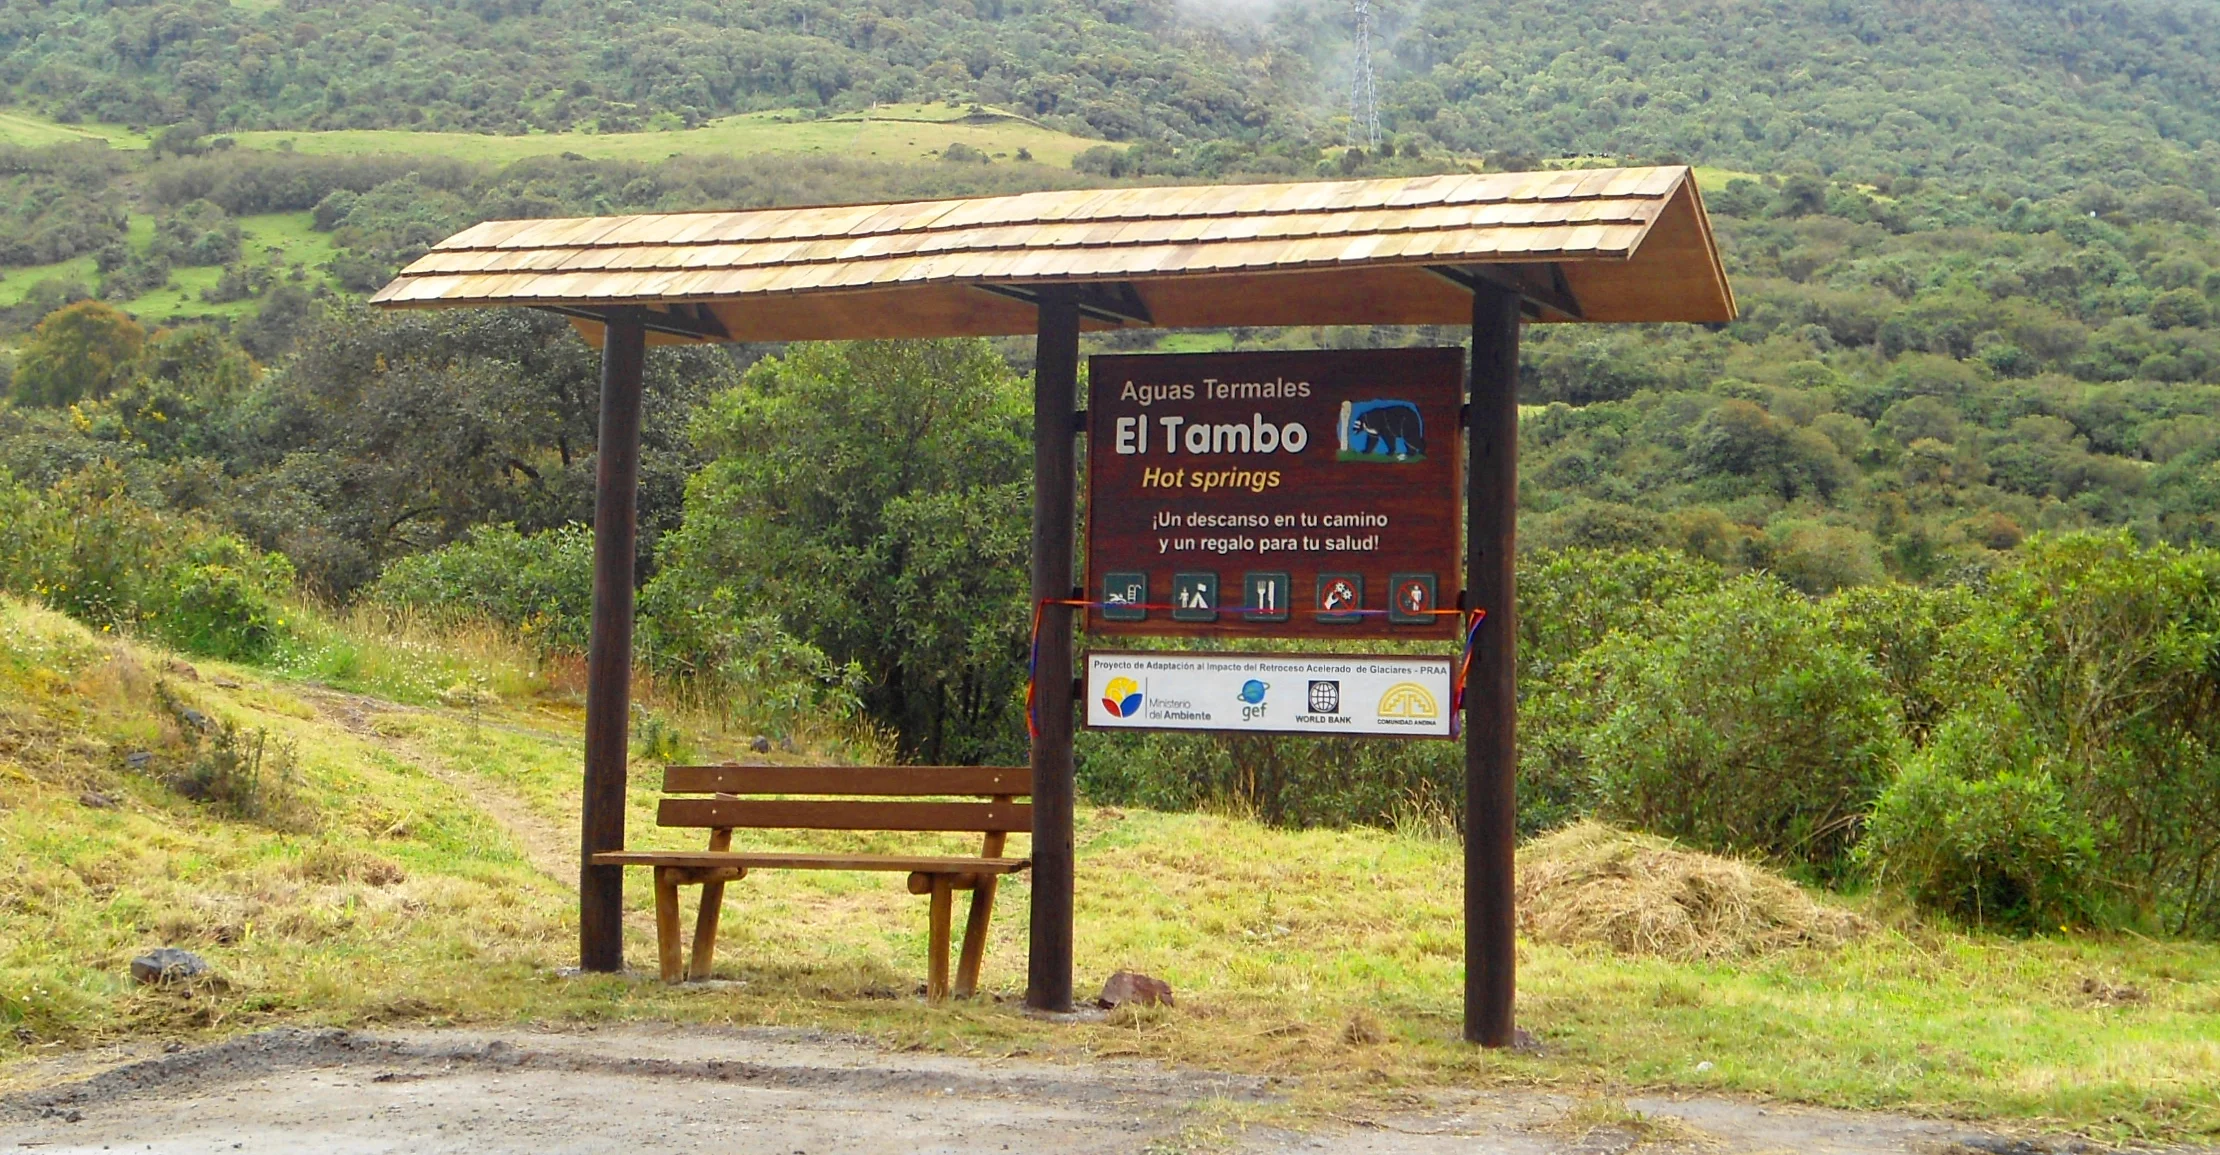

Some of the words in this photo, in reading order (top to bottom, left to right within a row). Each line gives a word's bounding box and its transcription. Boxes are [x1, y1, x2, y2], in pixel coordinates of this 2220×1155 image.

[1121, 381, 1195, 407] Aguas
[1203, 377, 1311, 400] Termales
[1116, 414, 1148, 455] El
[1160, 413, 1309, 455] Tambo
[1142, 467, 1184, 488] Hot
[1190, 467, 1281, 492] springs
[1153, 511, 1182, 531] ¡Un
[1186, 512, 1270, 528] descanso
[1274, 515, 1296, 528] en
[1301, 512, 1318, 527] tu
[1323, 511, 1388, 527] camino
[1159, 539, 1169, 554] y
[1174, 538, 1195, 551] un
[1200, 536, 1254, 554] regalo
[1259, 538, 1298, 554] para
[1303, 536, 1320, 551] tu
[1325, 535, 1379, 551] salud!
[1094, 660, 1132, 671] Proyecto
[1134, 661, 1145, 669] de
[1146, 661, 1195, 671] Adaptación
[1197, 662, 1205, 670] al
[1207, 663, 1241, 672] Impacto
[1243, 663, 1257, 671] del
[1260, 664, 1304, 672] Retroceso
[1306, 664, 1351, 673] Acelerado
[1356, 665, 1367, 673] de
[1370, 665, 1412, 674] Glaciares
[1420, 666, 1447, 674] PRAA
[1149, 698, 1191, 708] Ministerio
[1242, 703, 1268, 721] gef
[1149, 711, 1162, 719] del
[1164, 711, 1211, 720] Ambiente
[1296, 715, 1325, 723] WORLD
[1328, 716, 1351, 724] BANK
